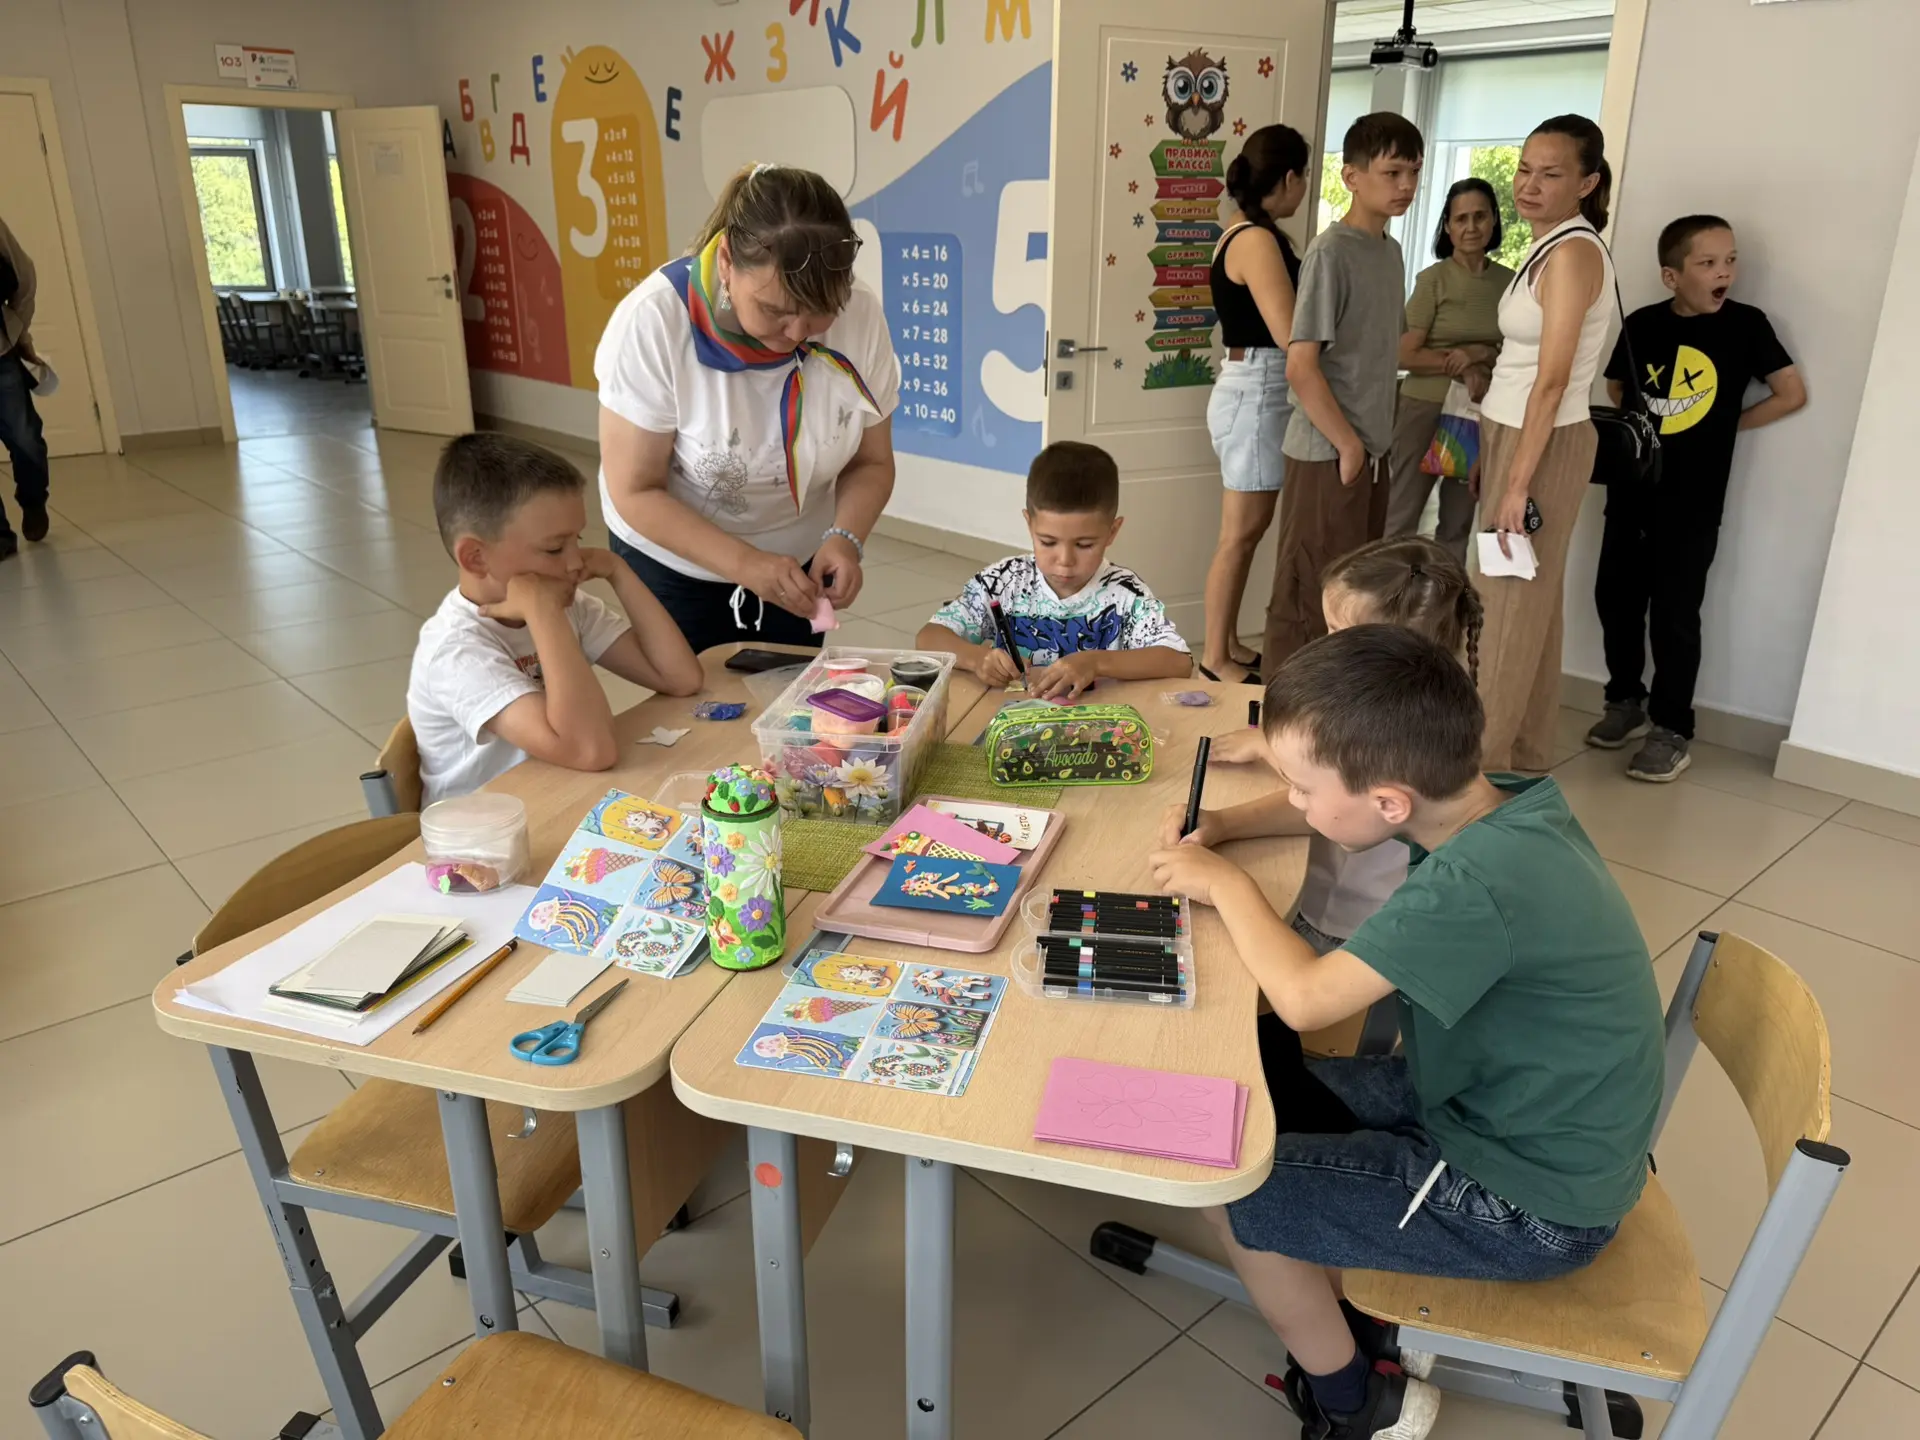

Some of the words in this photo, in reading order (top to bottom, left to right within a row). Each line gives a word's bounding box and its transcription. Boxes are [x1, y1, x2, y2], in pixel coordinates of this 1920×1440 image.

[825, 0, 862, 68] К
[220, 56, 242, 67] 103
[701, 30, 736, 84] Ж
[459, 79, 474, 122] Б
[491, 74, 500, 114] Г
[665, 86, 682, 141] Е
[870, 50, 908, 142] Й
[444, 119, 456, 159] А
[479, 119, 495, 162] В
[510, 112, 530, 166] Д
[1166, 148, 1217, 158] ПРАВИЛА
[1168, 160, 1212, 170] КЛАССА
[562, 118, 608, 258] 3
[981, 180, 1049, 422] 5
[1044, 740, 1098, 768] Avocado
